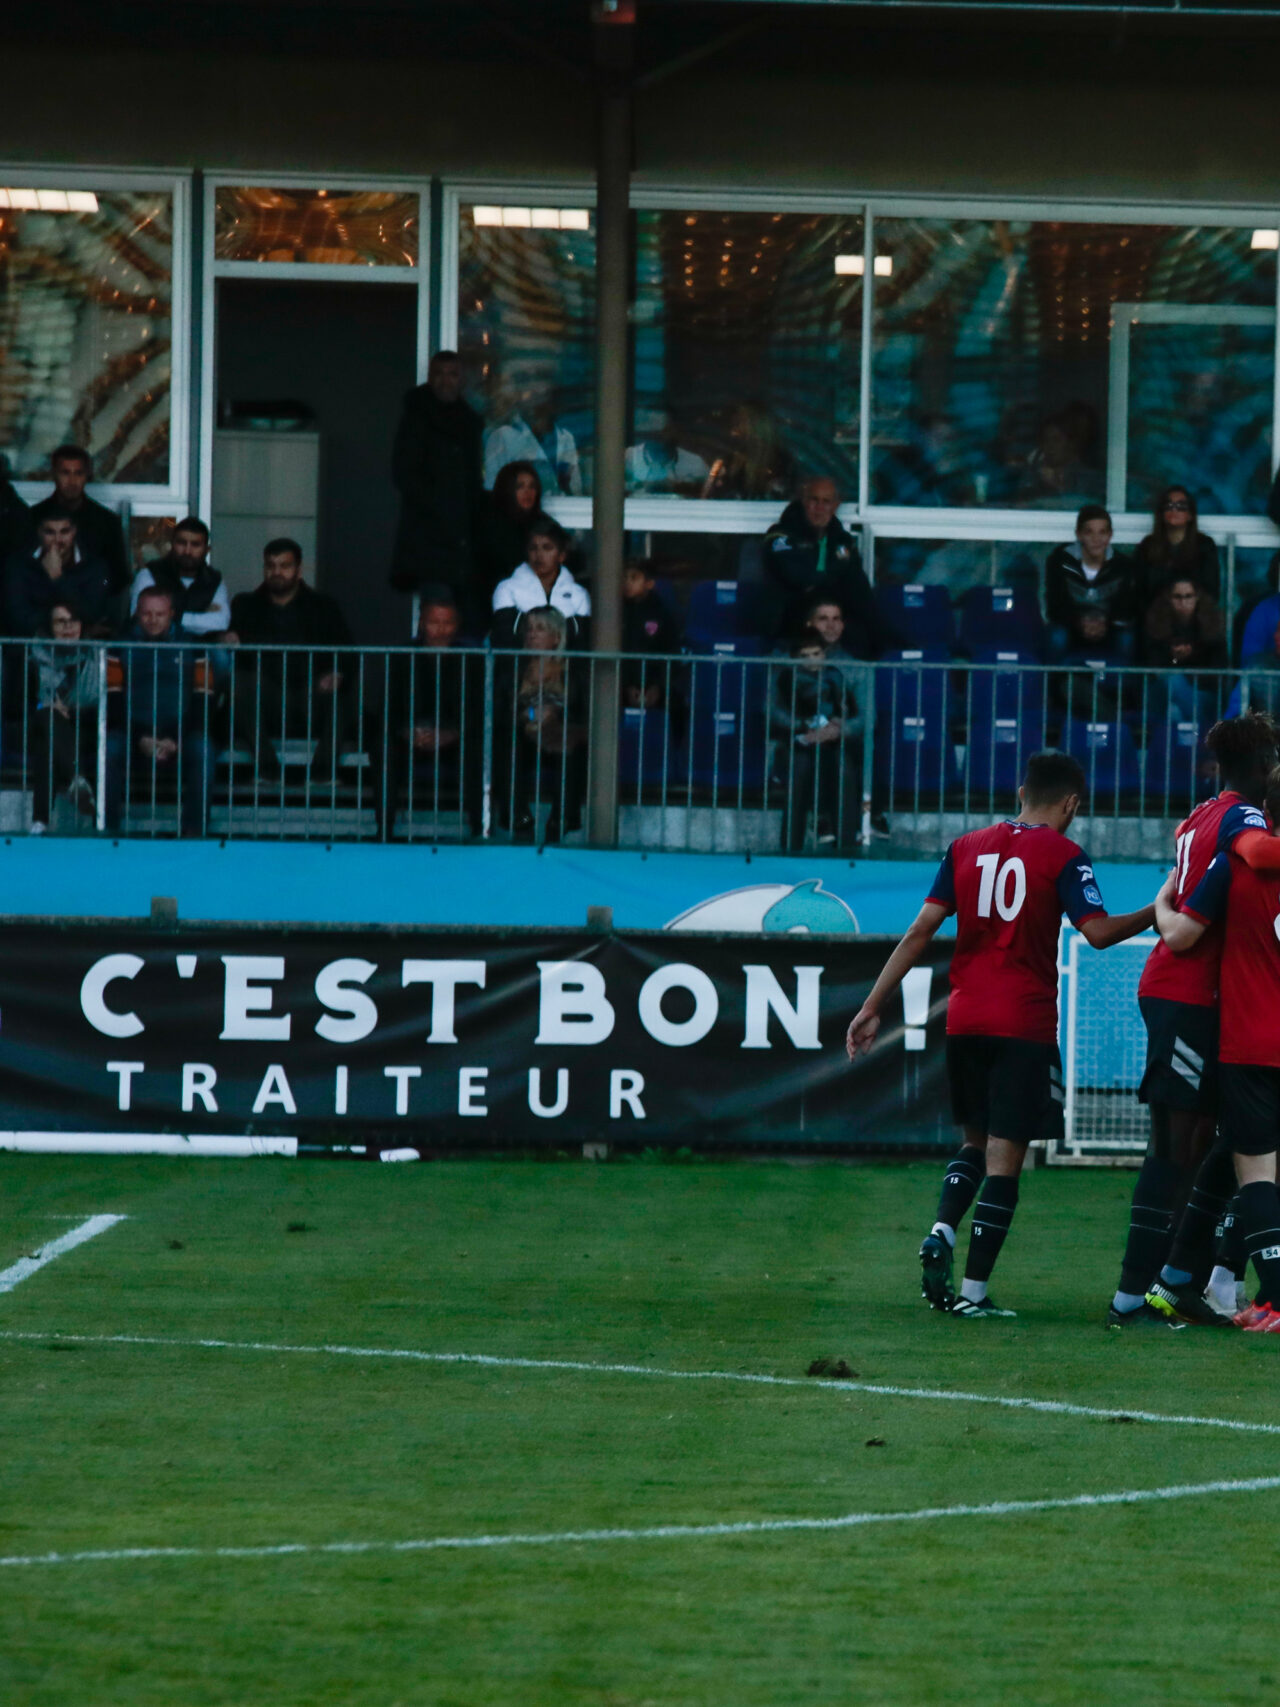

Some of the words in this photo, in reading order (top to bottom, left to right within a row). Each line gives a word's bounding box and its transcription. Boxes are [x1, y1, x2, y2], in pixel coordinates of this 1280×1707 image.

[975, 852, 1027, 922] 10
[80, 953, 487, 1044] C'EST
[534, 961, 824, 1049] BON
[901, 966, 933, 1051] !
[106, 1061, 647, 1119] TRAITEUR
